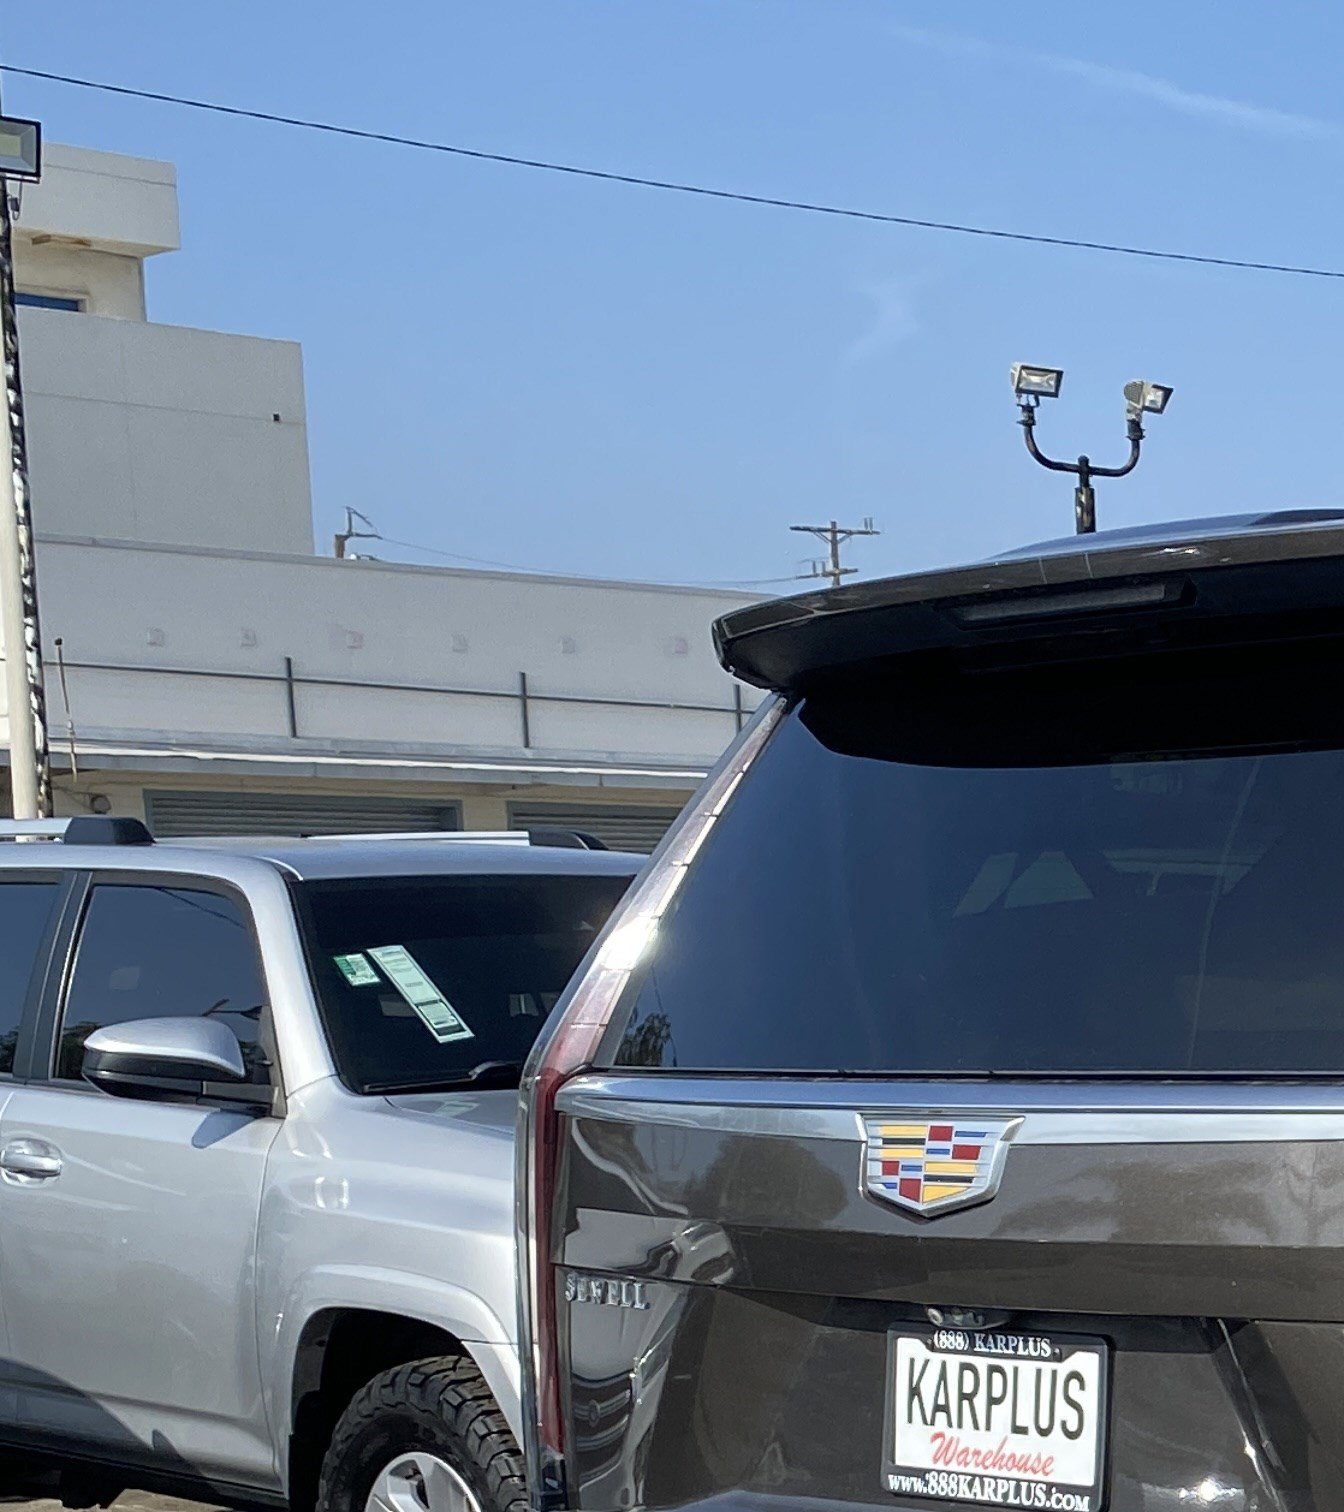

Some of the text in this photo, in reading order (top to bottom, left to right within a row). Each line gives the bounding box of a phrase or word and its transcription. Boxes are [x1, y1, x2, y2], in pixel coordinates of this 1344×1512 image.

[564, 1272, 650, 1310] SEWELL
[933, 1330, 1052, 1358] (888) KARPLUS
[907, 1357, 1086, 1441] KARPLUS
[929, 1431, 1055, 1477] Warehouse
